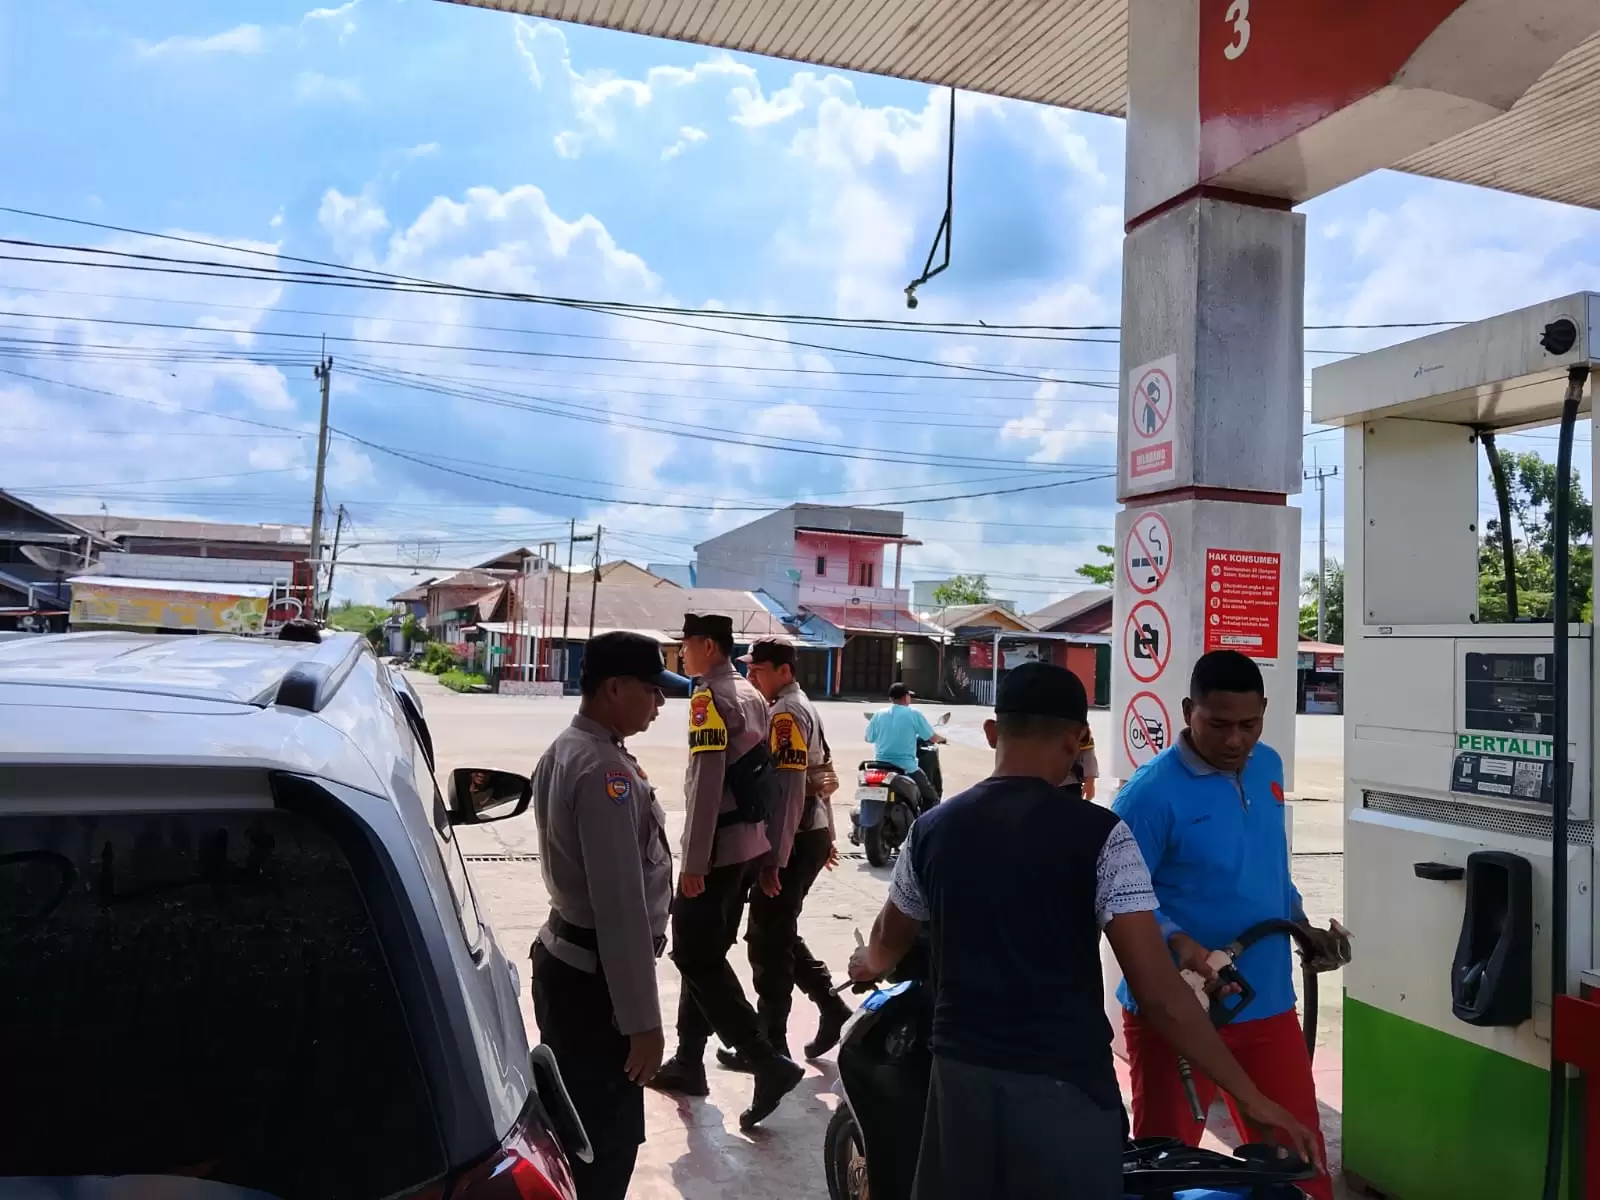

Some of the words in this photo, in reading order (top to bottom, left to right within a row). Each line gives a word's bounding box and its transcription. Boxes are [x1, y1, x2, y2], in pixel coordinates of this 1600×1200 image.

[1224, 0, 1250, 60] 3
[1208, 552, 1227, 561] HAK
[1229, 554, 1279, 565] KONSUMEN
[1132, 728, 1146, 740] ON
[1458, 734, 1554, 757] PERTALIT
